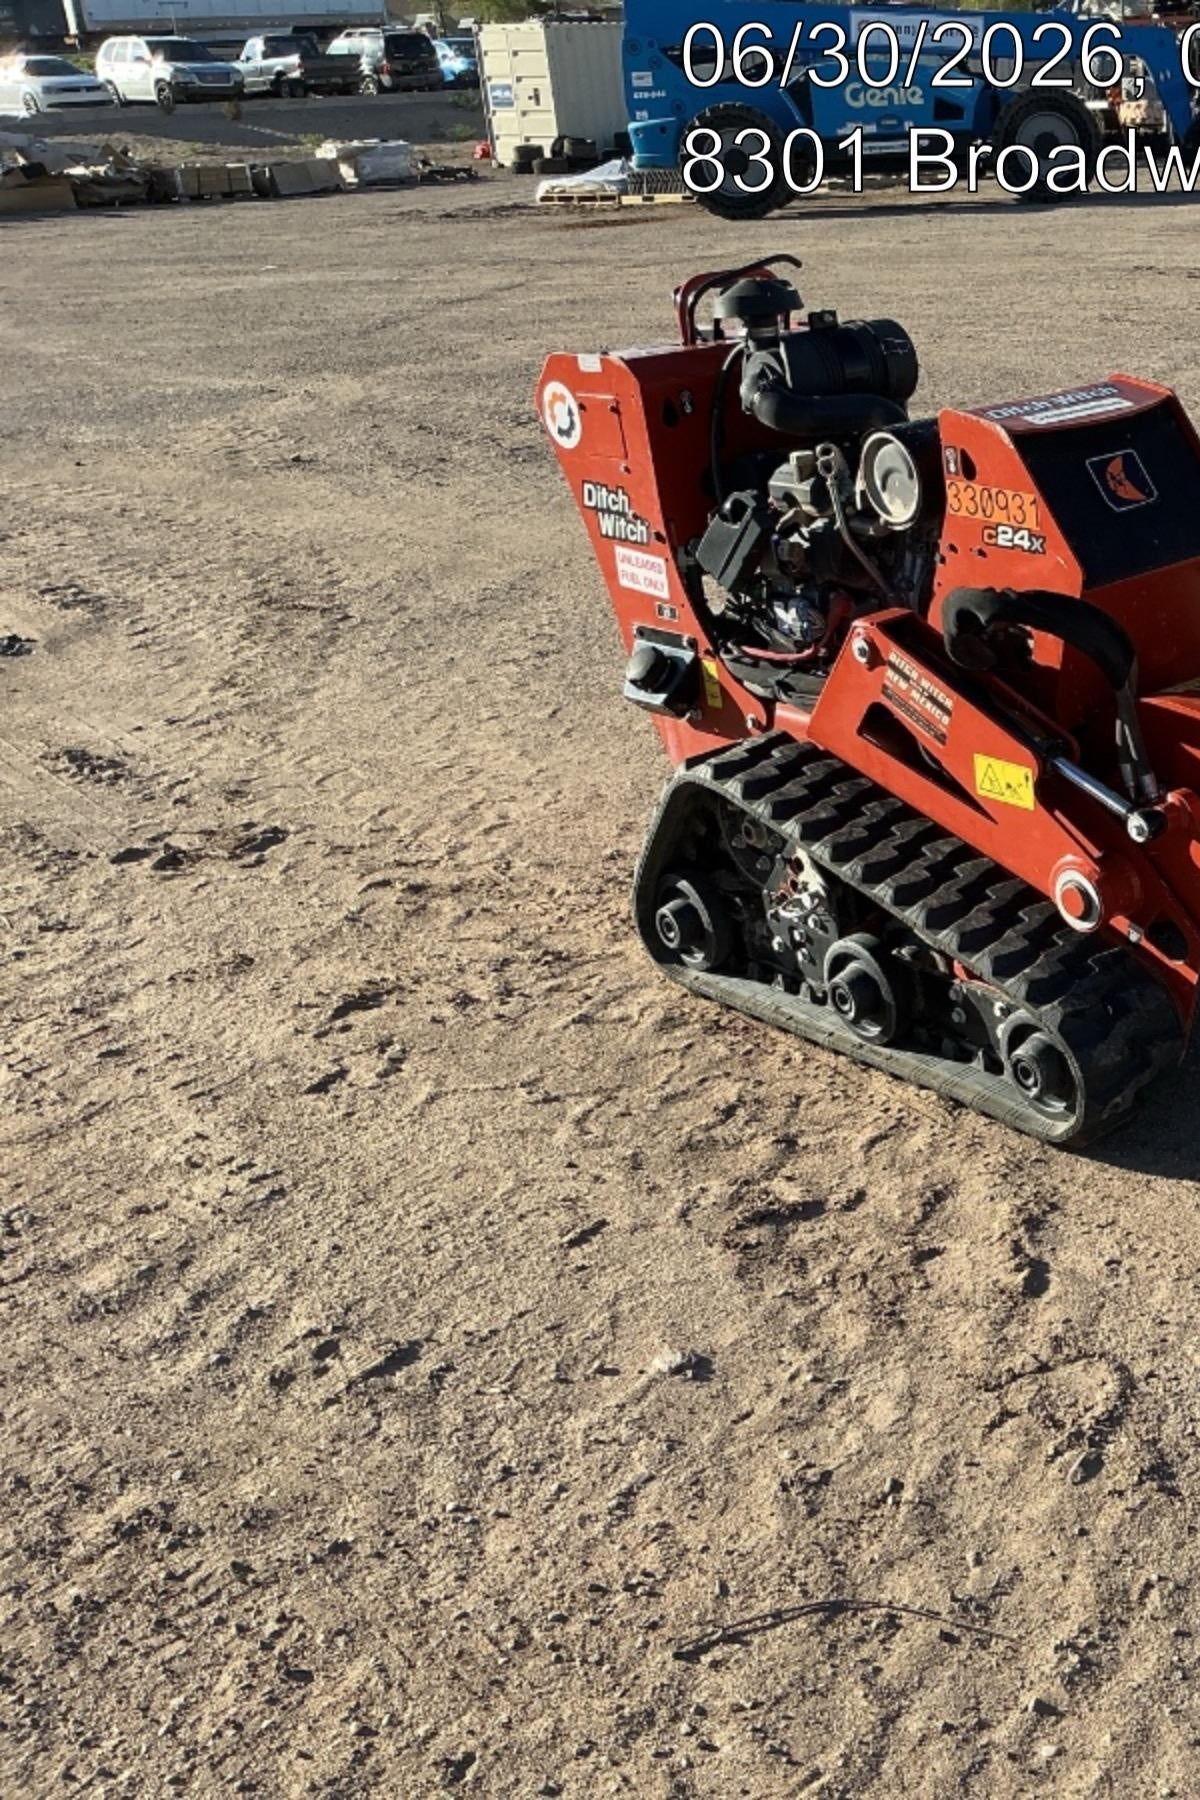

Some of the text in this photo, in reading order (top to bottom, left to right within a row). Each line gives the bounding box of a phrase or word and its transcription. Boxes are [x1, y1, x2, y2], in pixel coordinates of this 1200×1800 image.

[844, 82, 925, 108] Genie
[582, 482, 629, 513] Ditch
[947, 481, 1039, 528] 330931
[598, 511, 648, 544] Witch
[618, 551, 664, 576] UNLEADED
[621, 569, 642, 586] FUEL
[888, 651, 919, 681] DITCH
[920, 677, 954, 711] WITCH
[910, 689, 950, 726] MEXICO
